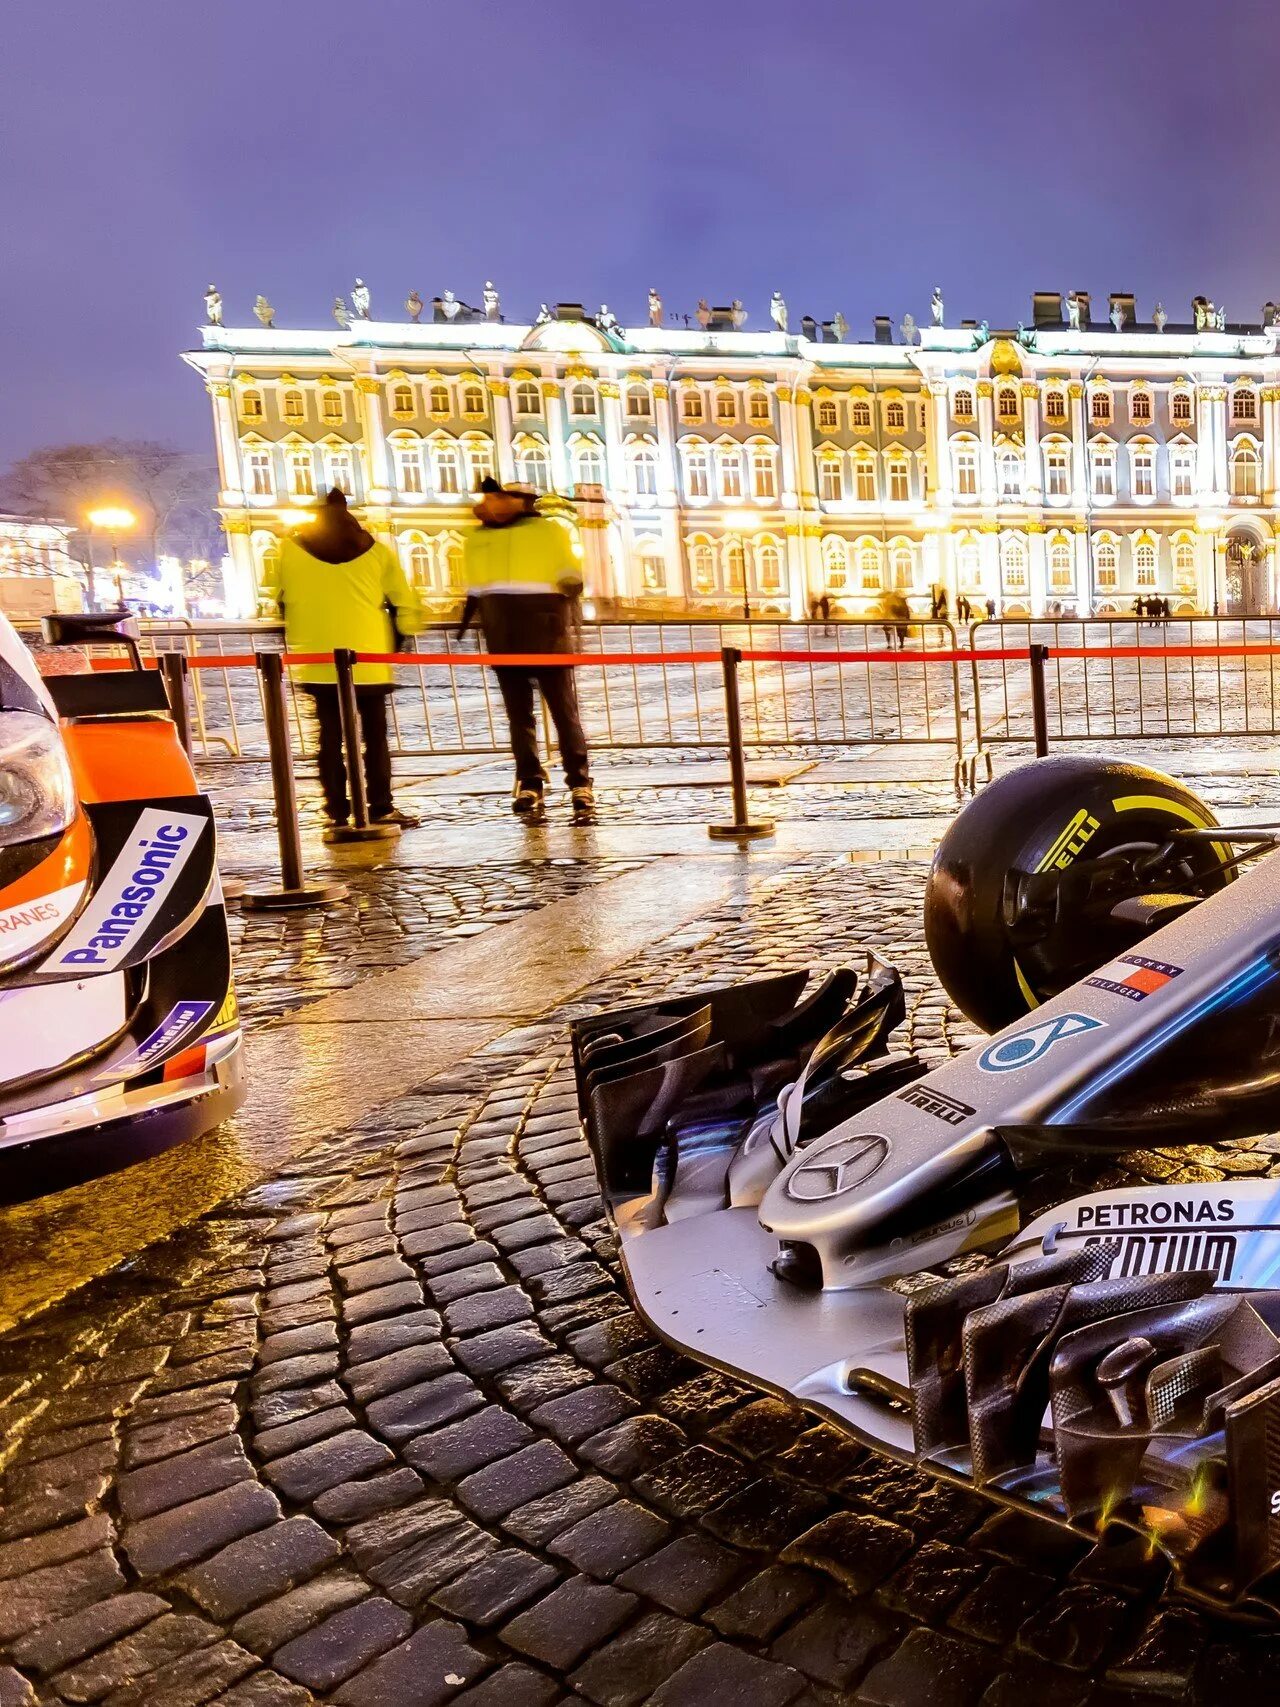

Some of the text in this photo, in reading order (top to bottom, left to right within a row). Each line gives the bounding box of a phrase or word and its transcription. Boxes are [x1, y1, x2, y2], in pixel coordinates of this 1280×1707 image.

[1033, 808, 1101, 874] PELLI
[60, 825, 188, 963] Panasonic
[1124, 955, 1178, 975] TOMMY
[1087, 978, 1142, 999] HILFIGER
[135, 1010, 195, 1062] MICHELIN
[896, 1084, 977, 1126] PIRELLI
[1077, 1200, 1235, 1228] PETRONAS
